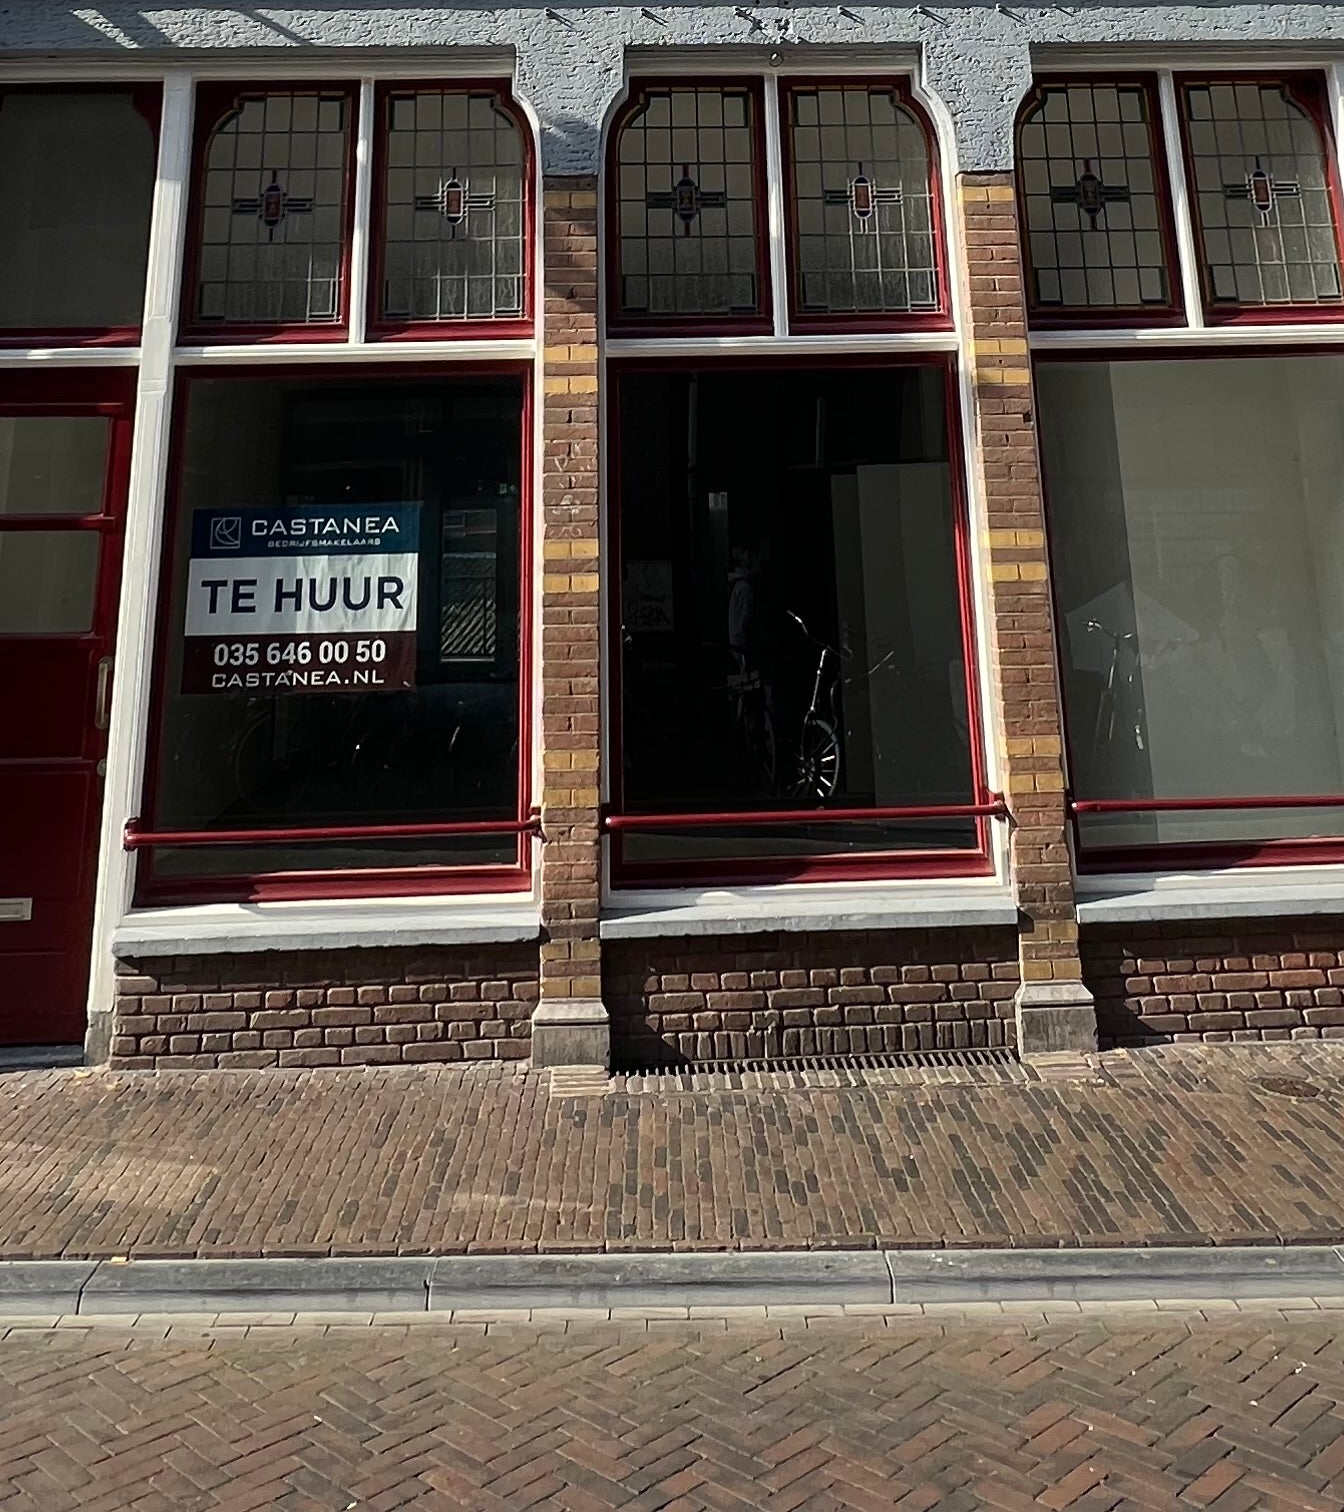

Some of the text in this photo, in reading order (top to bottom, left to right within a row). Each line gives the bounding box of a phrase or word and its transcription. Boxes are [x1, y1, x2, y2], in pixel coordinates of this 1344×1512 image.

[252, 517, 400, 535] CASTANEA
[267, 537, 381, 548] BEDRIJFSMAKELAARS
[201, 576, 405, 613] TE HUUR
[213, 639, 386, 666] 035 646 00 50
[212, 669, 385, 689] CASTANEA.NL
